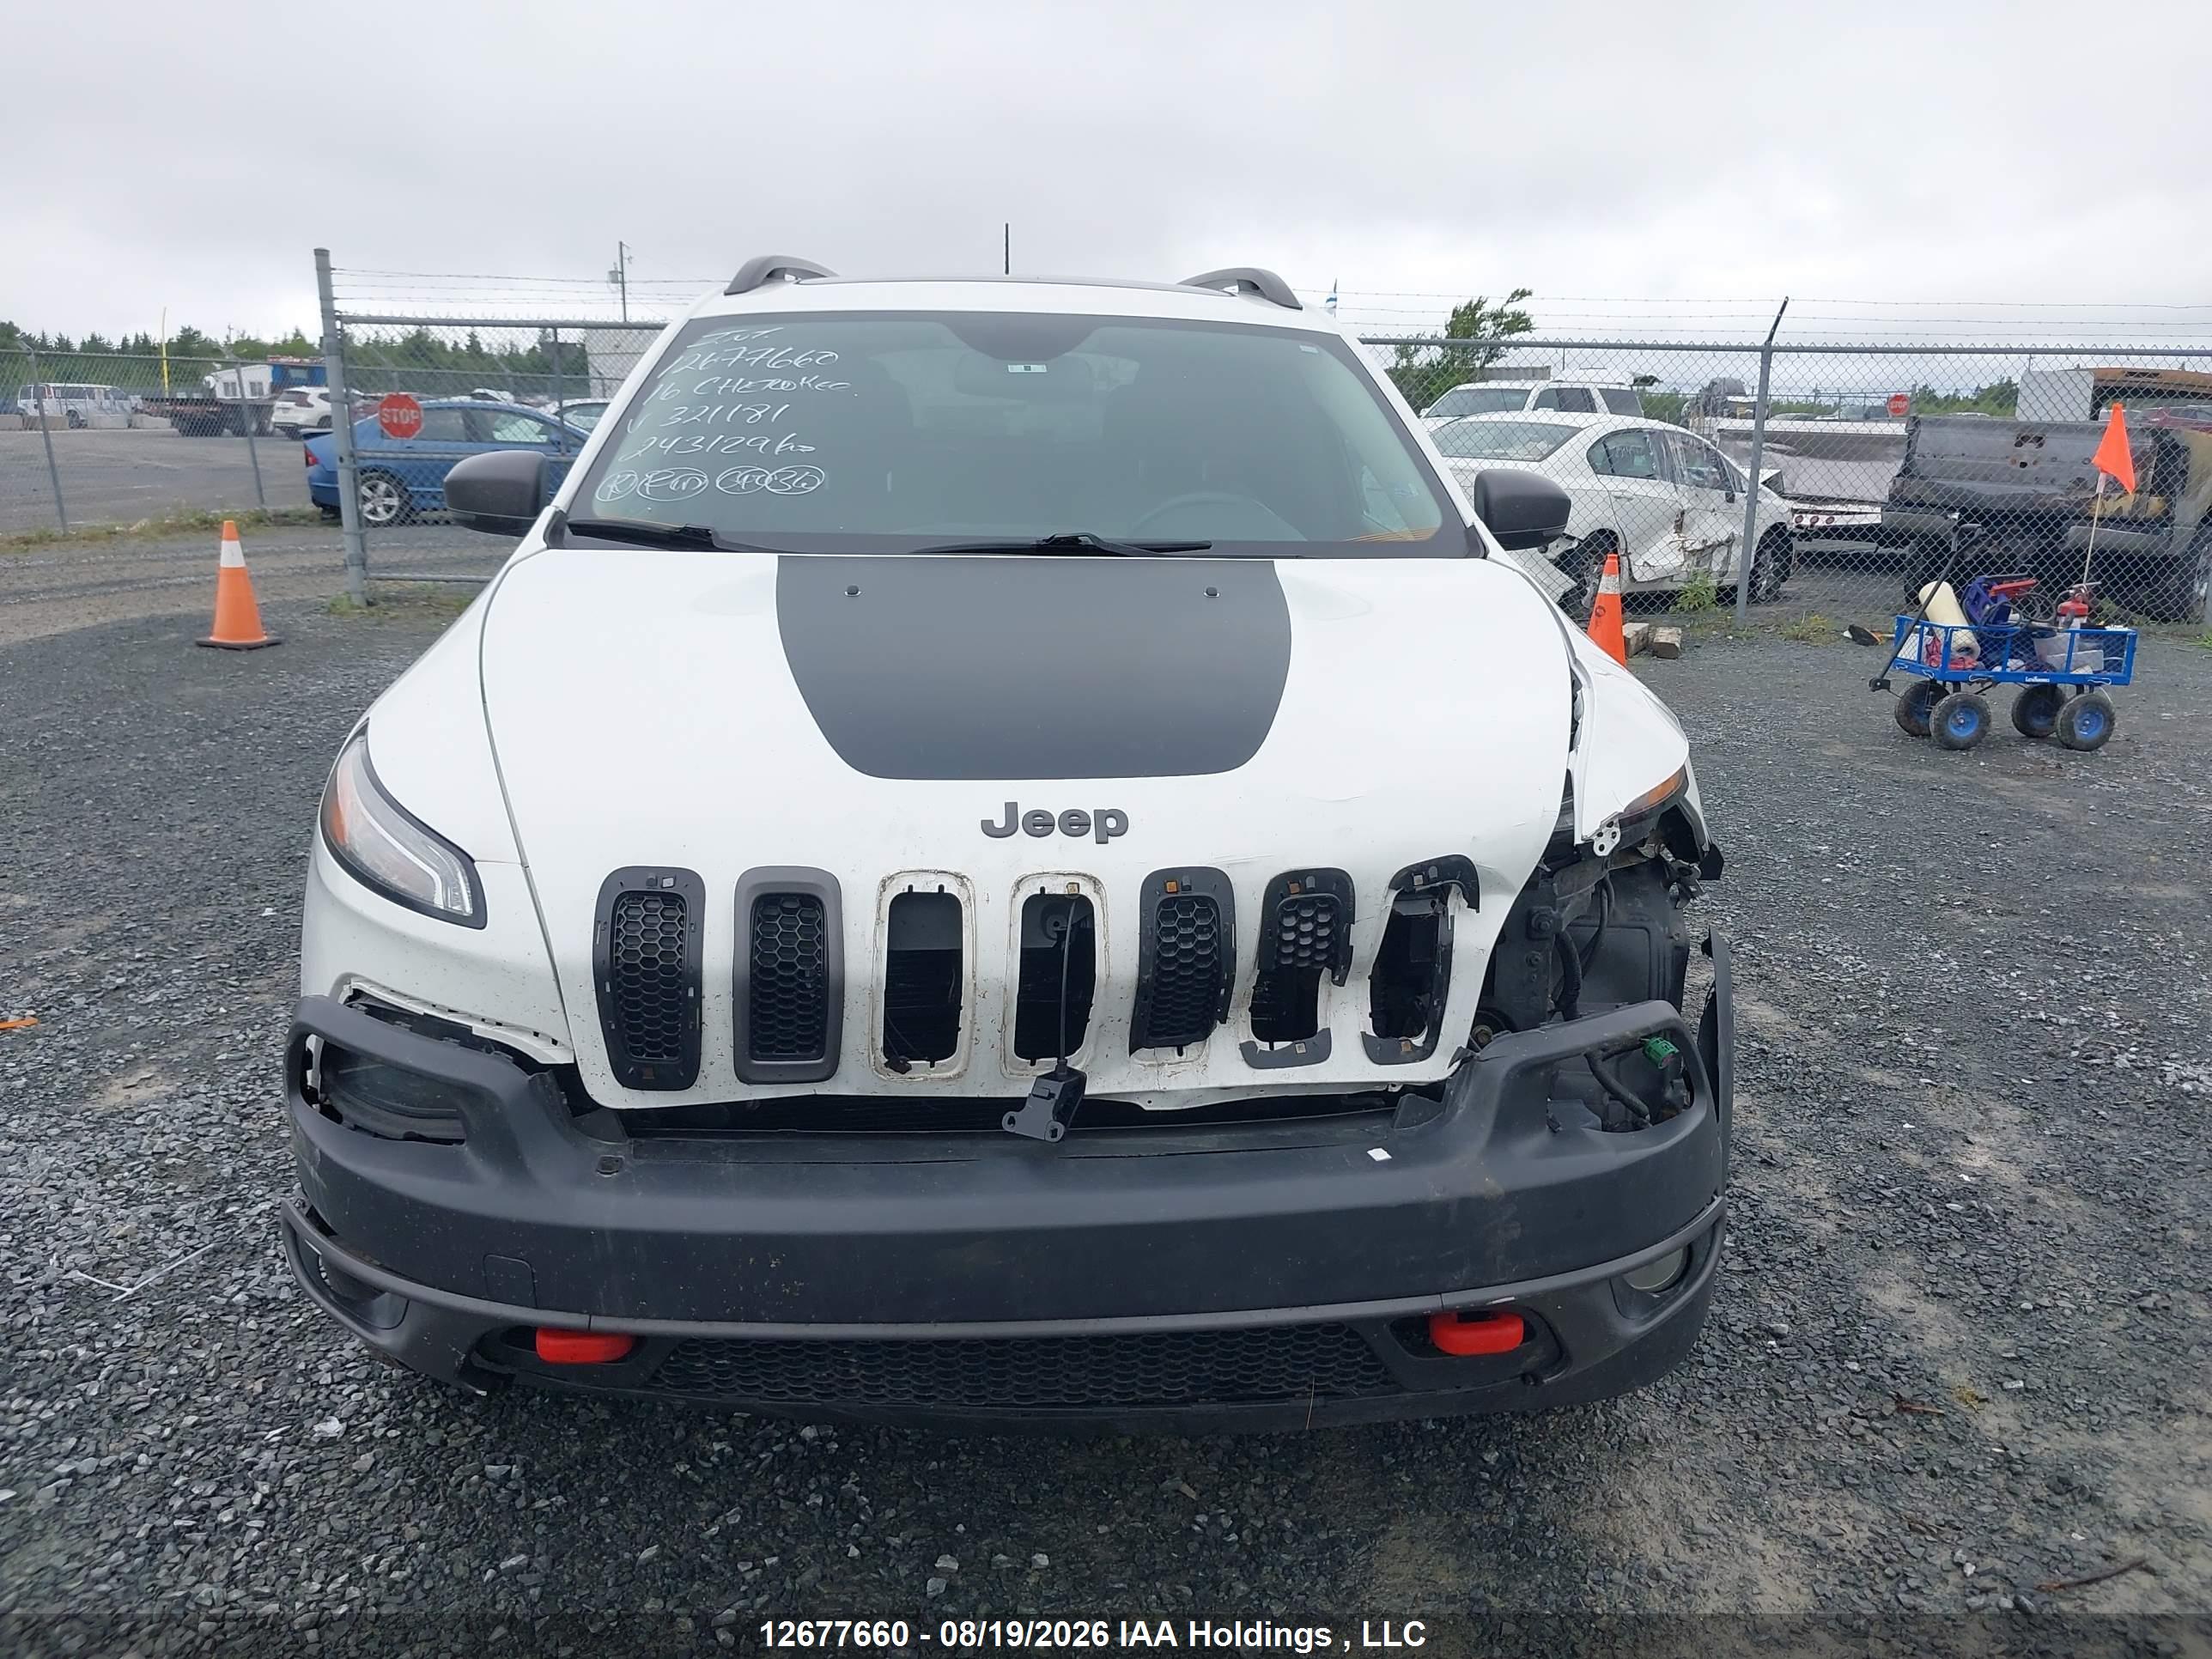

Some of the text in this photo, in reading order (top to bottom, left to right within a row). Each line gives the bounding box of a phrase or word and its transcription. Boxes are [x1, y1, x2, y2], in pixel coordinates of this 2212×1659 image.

[657, 346, 839, 380] 12677660
[642, 381, 681, 405] 16
[381, 407, 421, 424] STOP
[659, 403, 791, 428] 321181
[981, 801, 1129, 844] Jeep
